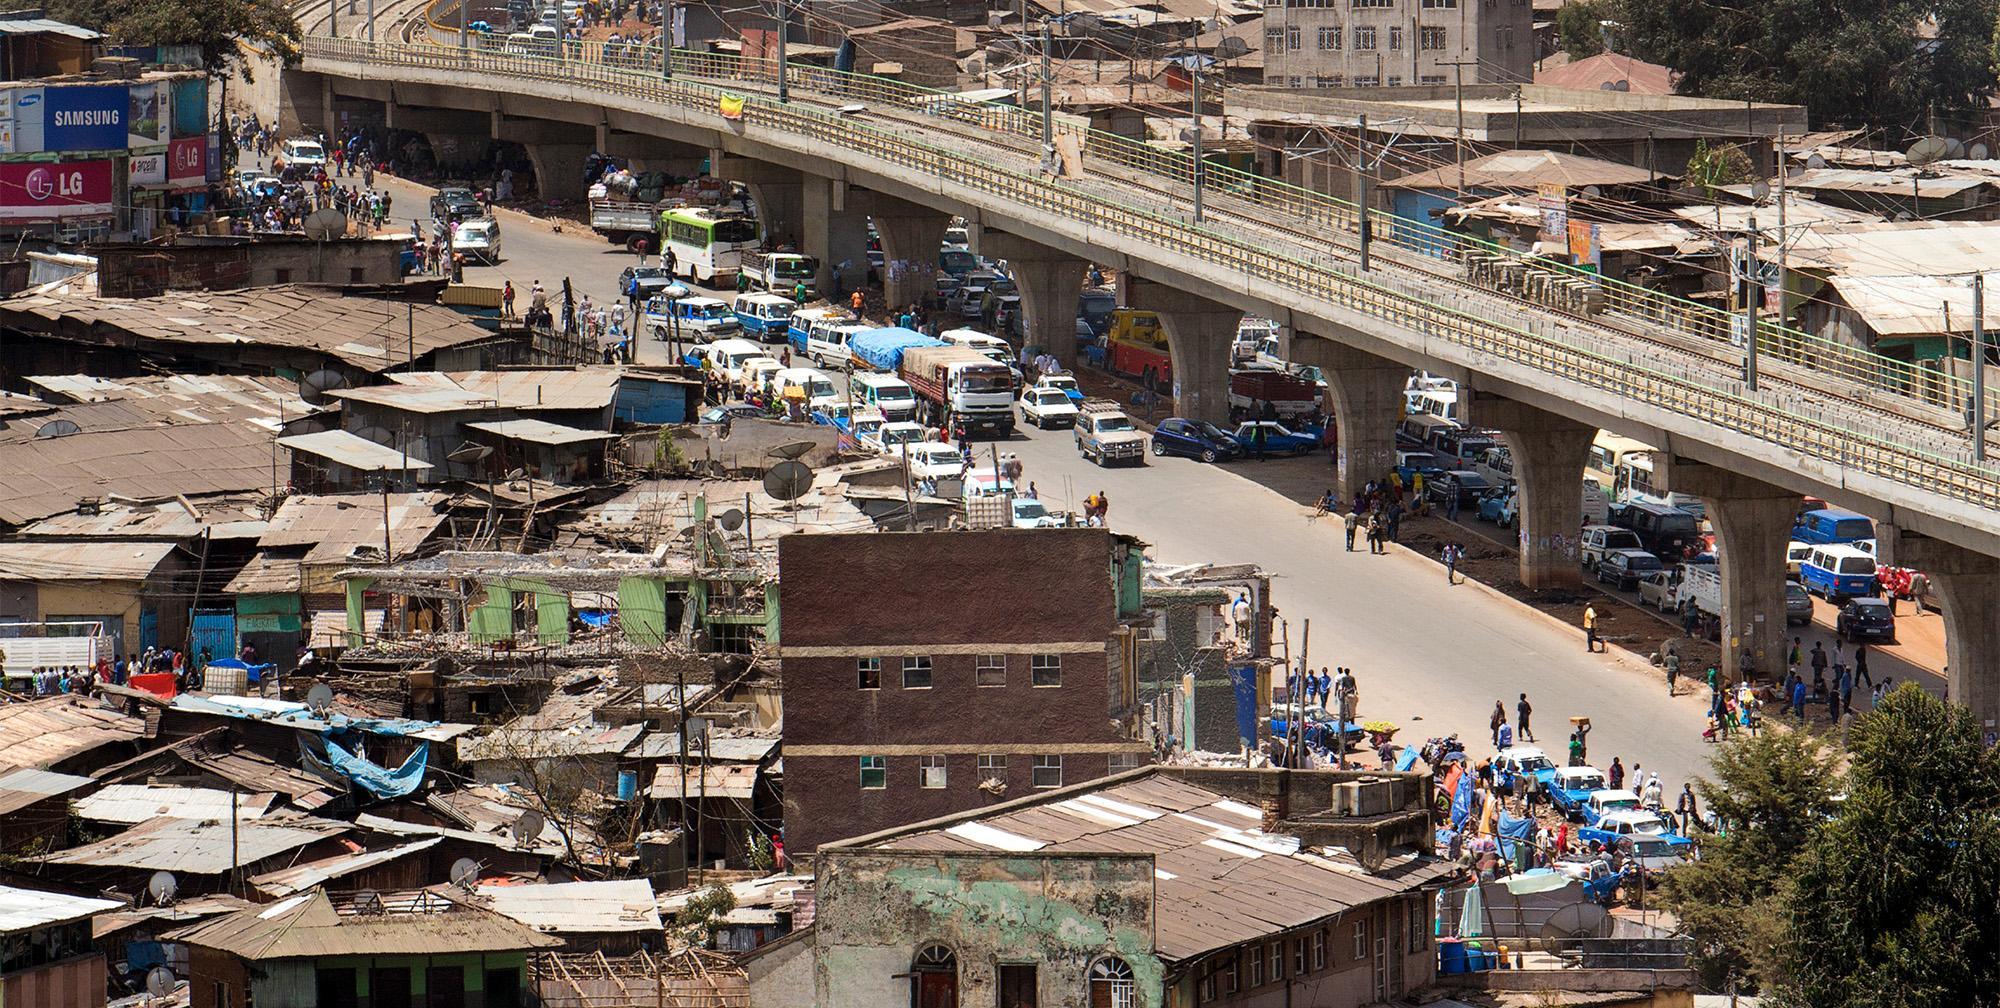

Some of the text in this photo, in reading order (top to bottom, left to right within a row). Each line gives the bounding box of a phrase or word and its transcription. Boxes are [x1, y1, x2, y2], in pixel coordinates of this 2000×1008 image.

[55, 110, 119, 126] SAMSUNG
[187, 147, 198, 167] LG
[60, 172, 83, 195] LG
